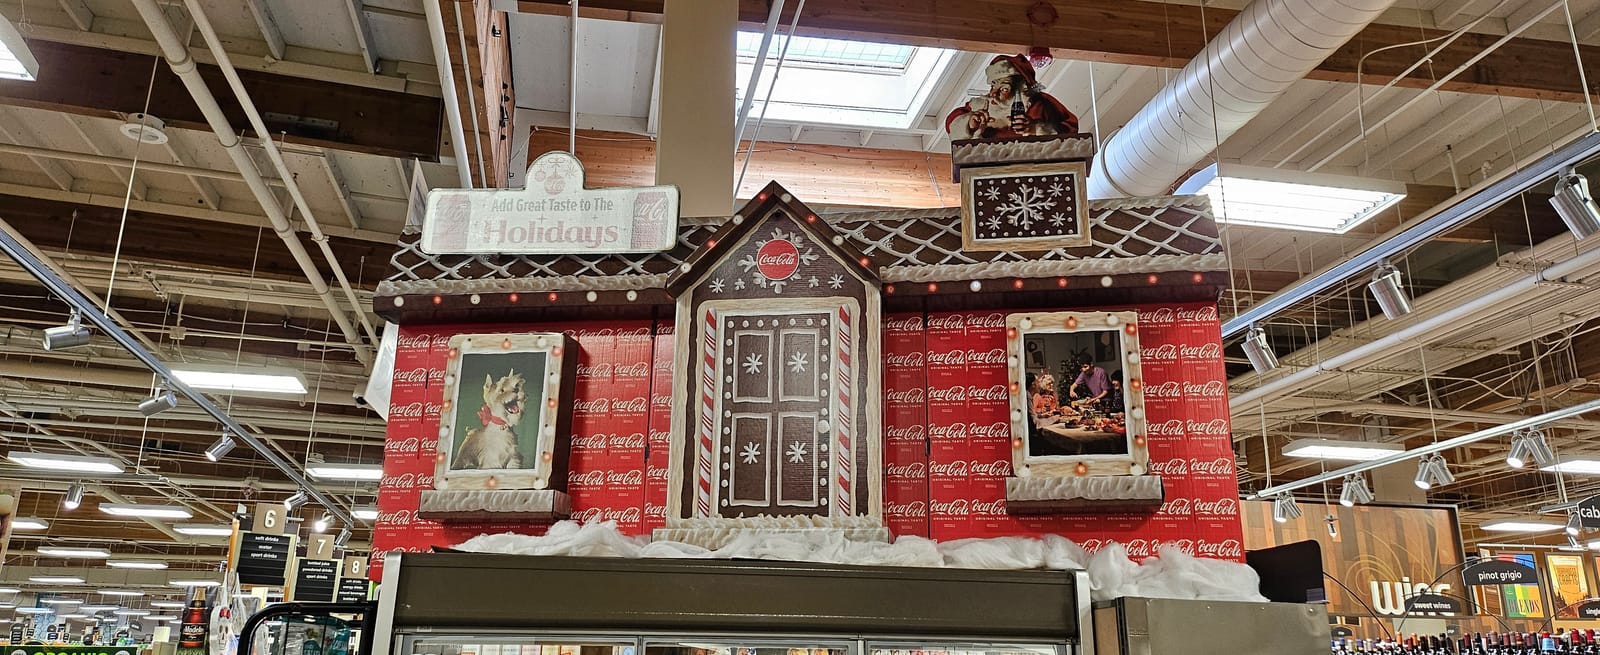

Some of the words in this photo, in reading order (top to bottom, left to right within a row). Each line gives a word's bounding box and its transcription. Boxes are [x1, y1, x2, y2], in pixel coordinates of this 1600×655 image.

[491, 199, 512, 212] Add
[516, 198, 546, 212] Great
[549, 198, 576, 211] Taste
[580, 199, 590, 210] to
[593, 197, 614, 210] The
[484, 220, 618, 248] Holidays
[759, 253, 796, 266] Coca-Cola
[1139, 308, 1174, 322] ca-Cola
[1140, 344, 1177, 359] ca-Cola
[1142, 382, 1180, 397] ca-Cola
[1147, 419, 1184, 435] ca-Cola
[1150, 458, 1187, 475] ca-Cola
[264, 510, 276, 528] 6
[318, 539, 326, 554] 7
[352, 560, 360, 573] 8
[1478, 571, 1499, 582] pinot
[1500, 570, 1522, 581] grigio
